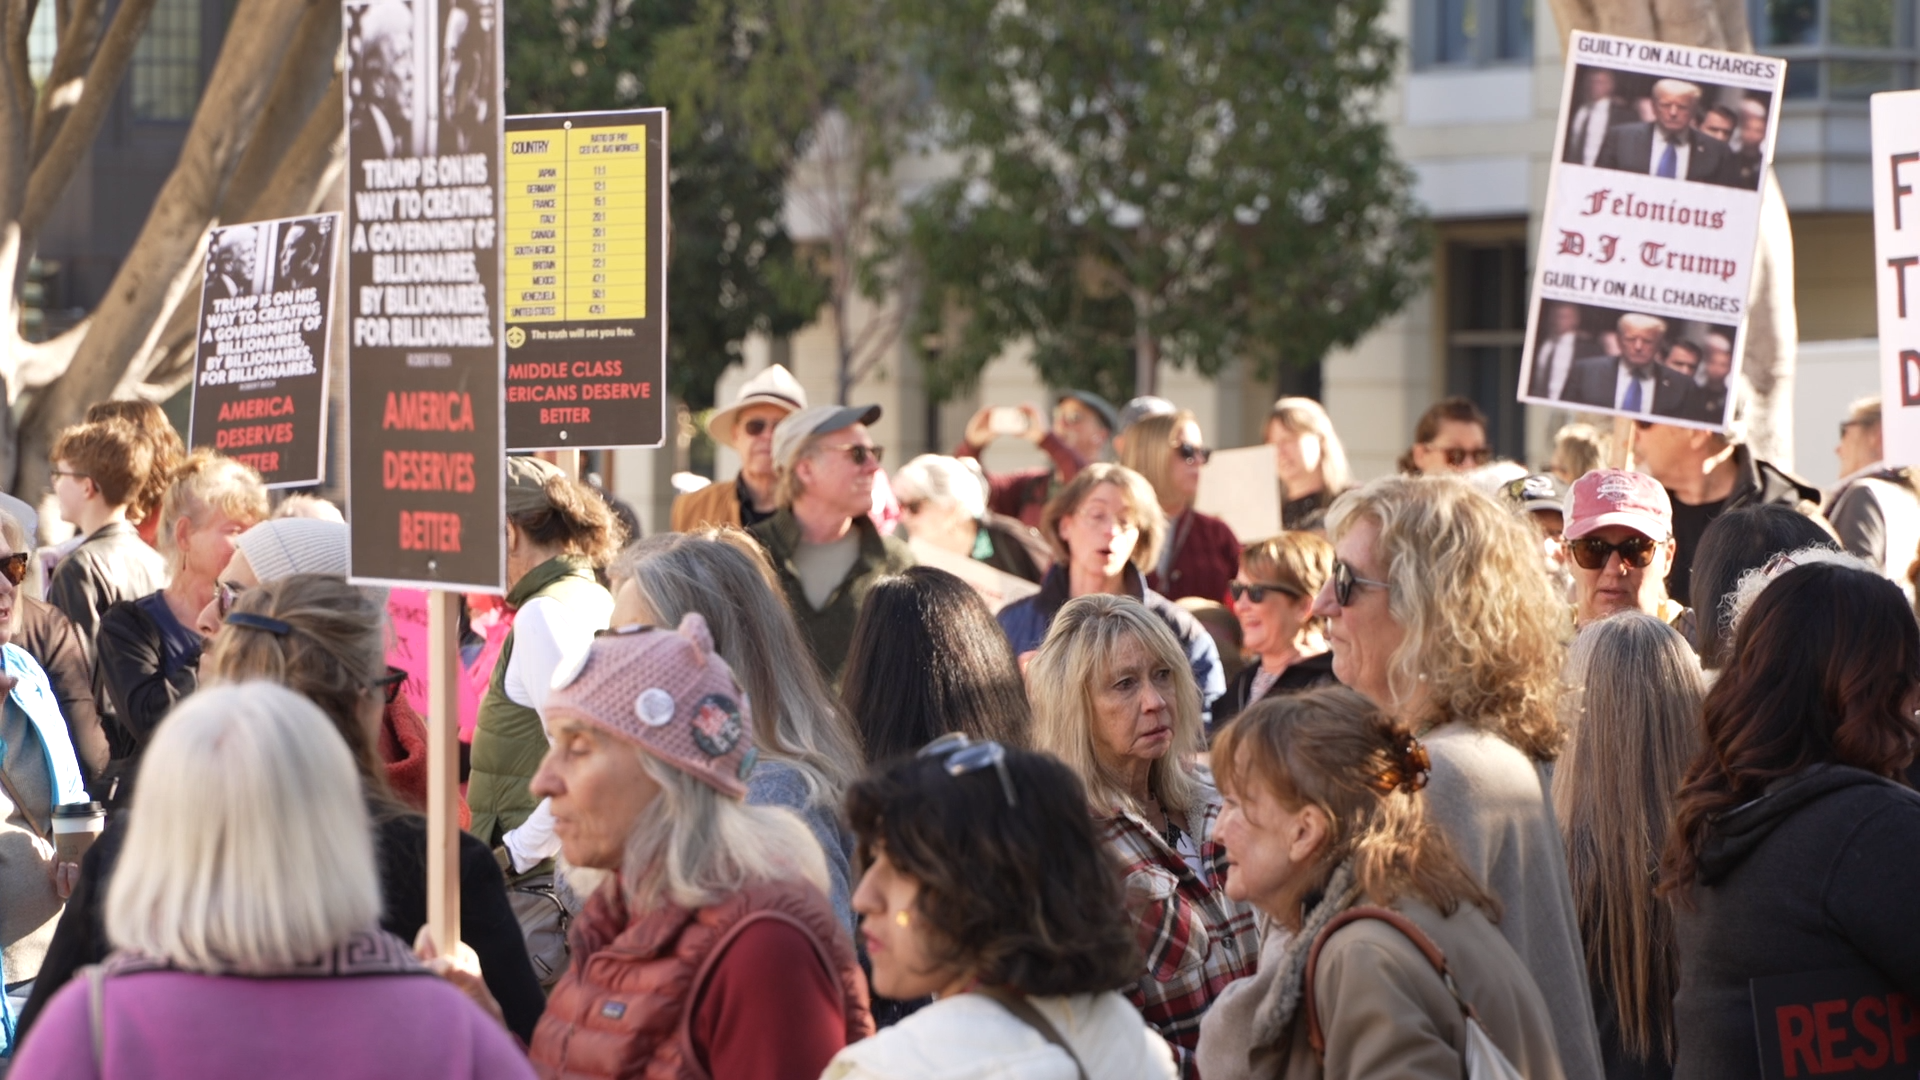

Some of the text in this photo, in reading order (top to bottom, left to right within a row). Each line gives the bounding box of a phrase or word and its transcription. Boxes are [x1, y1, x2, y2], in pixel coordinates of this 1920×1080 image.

[1578, 36, 1635, 58] GUILTY
[1638, 45, 1660, 63] ON
[1664, 50, 1692, 68] ALL
[1697, 54, 1776, 79] CHARGES
[511, 140, 549, 154] COUNTRY
[362, 153, 488, 189] TRUMP IS ON HIS
[538, 168, 556, 178] JAPAN
[527, 184, 556, 194] GERMANY
[355, 186, 493, 221] WAY TO CREATING
[532, 199, 556, 209] FRANCE
[1580, 188, 1726, 230] Felonious
[540, 214, 556, 224] ITALY
[351, 218, 495, 252] A GOVERNMENT OF
[531, 230, 555, 240] CANADA
[514, 245, 555, 256] SOUTH AFRICA
[1556, 228, 1737, 282] D.J. Trump
[532, 260, 556, 270] BRITAIN
[532, 276, 556, 286] MEXICO
[1542, 270, 1600, 293] GUILTY
[1603, 280, 1626, 297] ON
[1630, 284, 1658, 304] ALL
[1662, 289, 1741, 314] CHARGES
[212, 287, 317, 313] TRUMP IS ON HIS
[360, 285, 384, 315] BY
[521, 291, 555, 302] VENEZUELA
[206, 301, 320, 328] WAY TO CREATING
[202, 315, 322, 344] A GOVERNMENT OF
[354, 316, 390, 347] FOR
[531, 326, 635, 340] The truth will set you free.
[216, 332, 305, 356] BILLIONAIRES,
[206, 345, 313, 371] BY BILLIONAIRES,
[508, 360, 622, 380] MIDDLE CLASS
[200, 360, 316, 387] FOR BILLIONAIRES.
[582, 382, 650, 400] DESERVE
[218, 395, 294, 422] AMERICA
[382, 391, 475, 432] AMERICA
[540, 407, 590, 424] BETTER
[216, 422, 294, 450] DESERVES
[230, 452, 279, 473] ETTER
[382, 450, 476, 493] DESERVES
[399, 511, 461, 552] BETTER
[1776, 991, 1920, 1078] RESP
